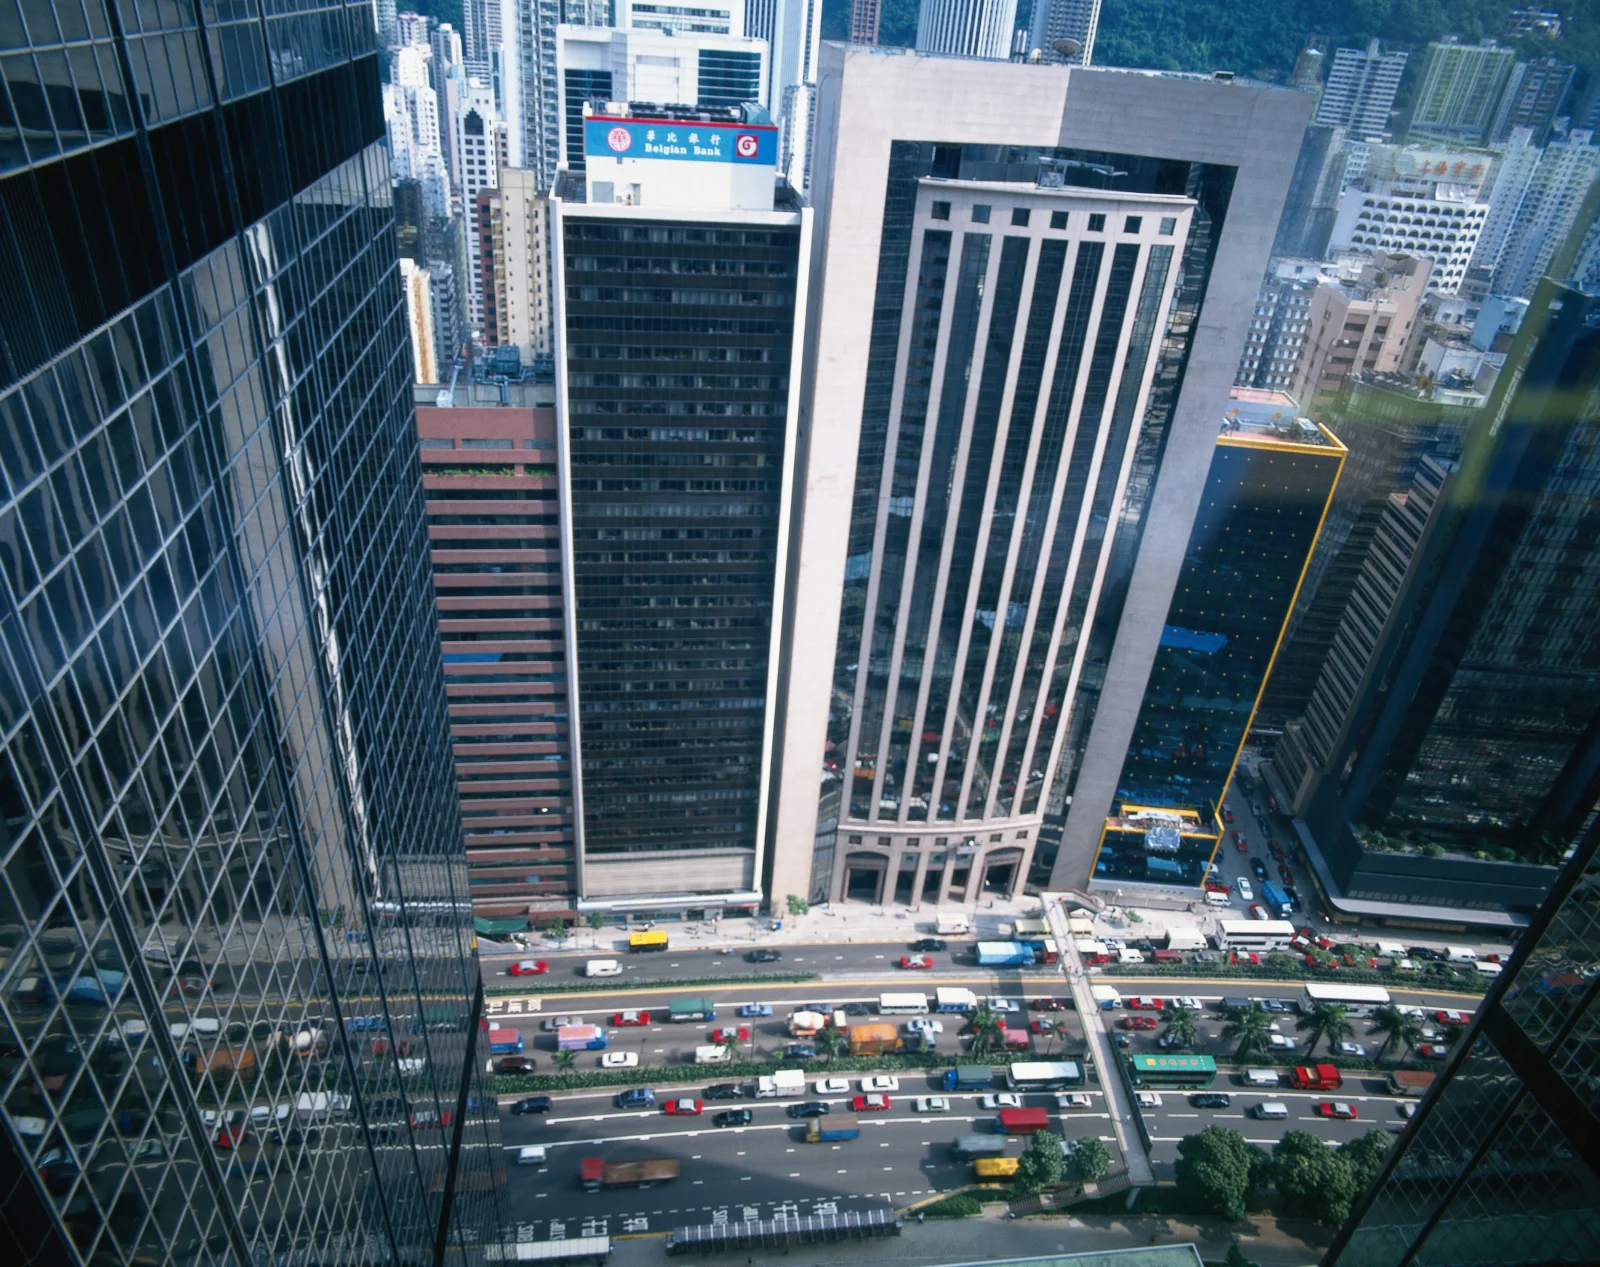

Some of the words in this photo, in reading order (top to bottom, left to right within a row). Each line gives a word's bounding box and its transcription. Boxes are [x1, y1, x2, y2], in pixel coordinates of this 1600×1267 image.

[646, 129, 721, 145] 華比銀行
[645, 143, 687, 155] Belgian
[693, 145, 721, 156] Bank
[517, 1224, 534, 1242] BUS
[550, 1221, 565, 1240] STOP
[582, 1219, 607, 1237] 巴士
